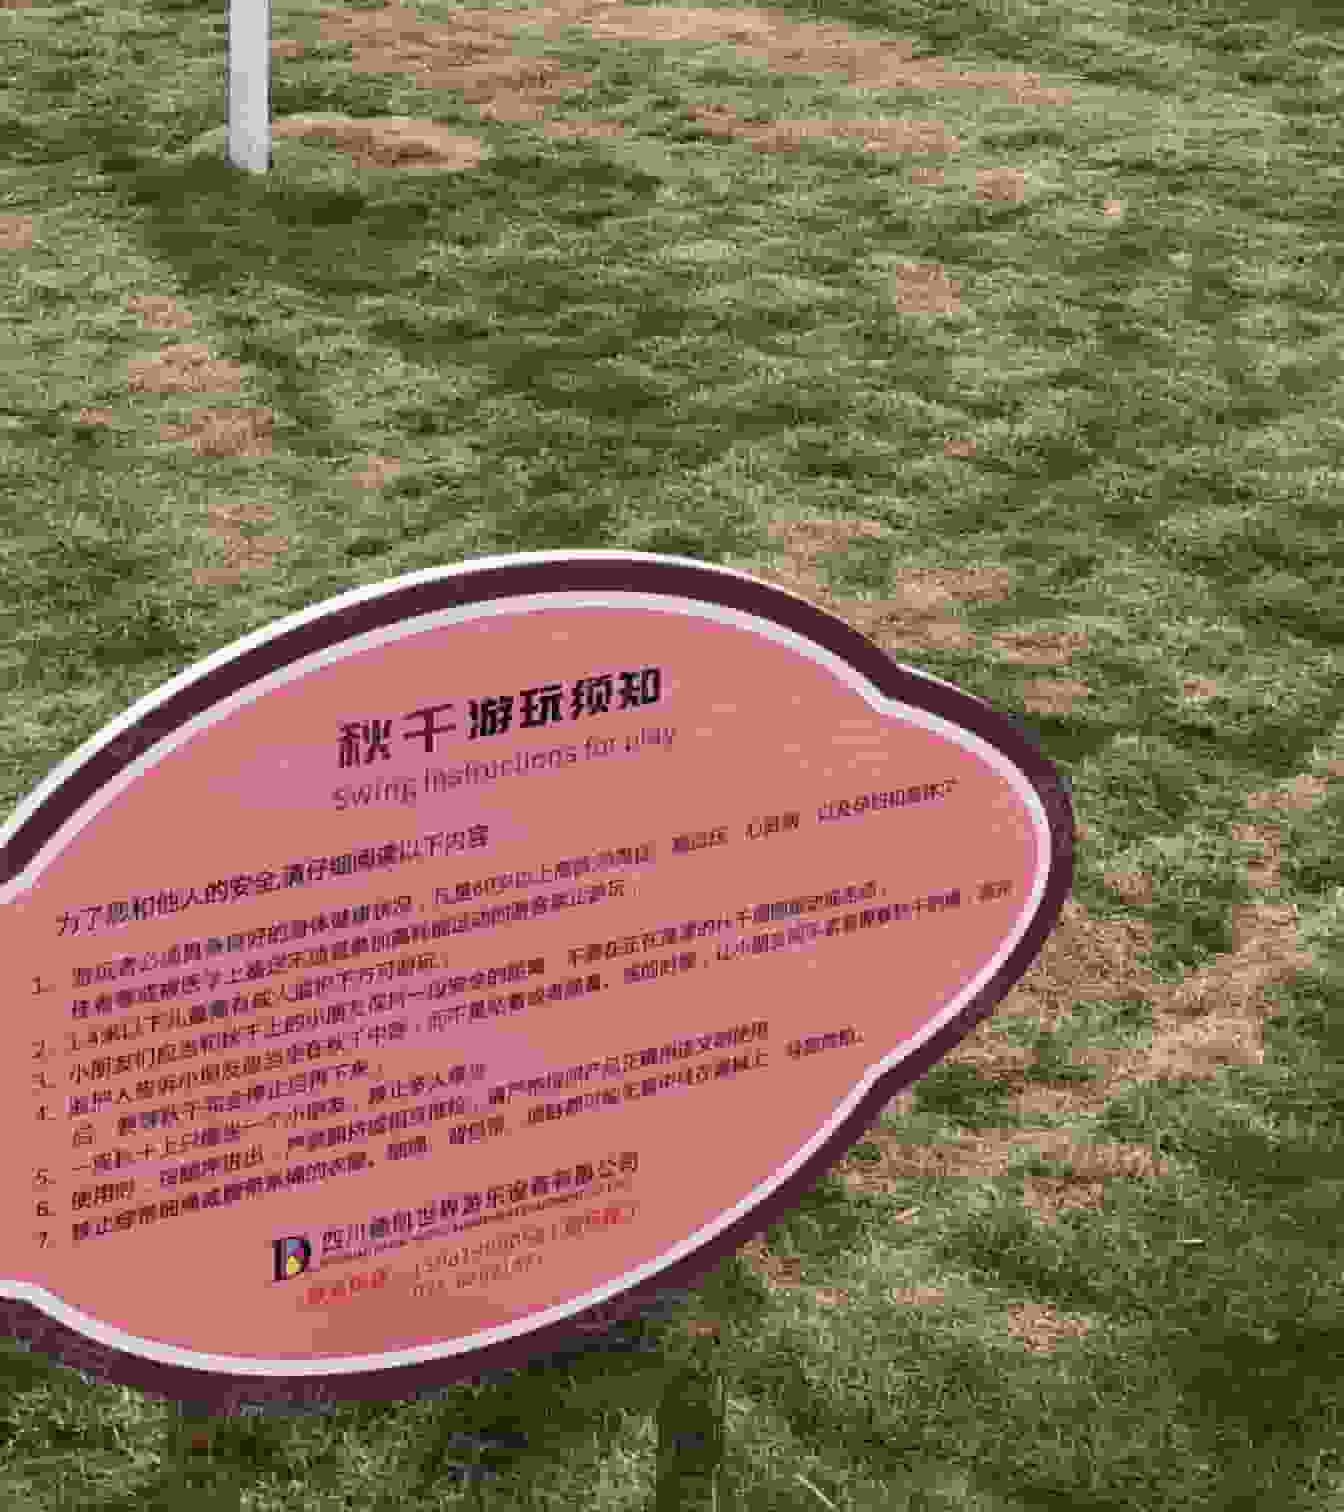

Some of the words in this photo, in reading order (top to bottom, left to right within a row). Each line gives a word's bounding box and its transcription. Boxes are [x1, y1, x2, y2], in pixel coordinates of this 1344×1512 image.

[337, 665, 662, 769] 秋千游玩须知
